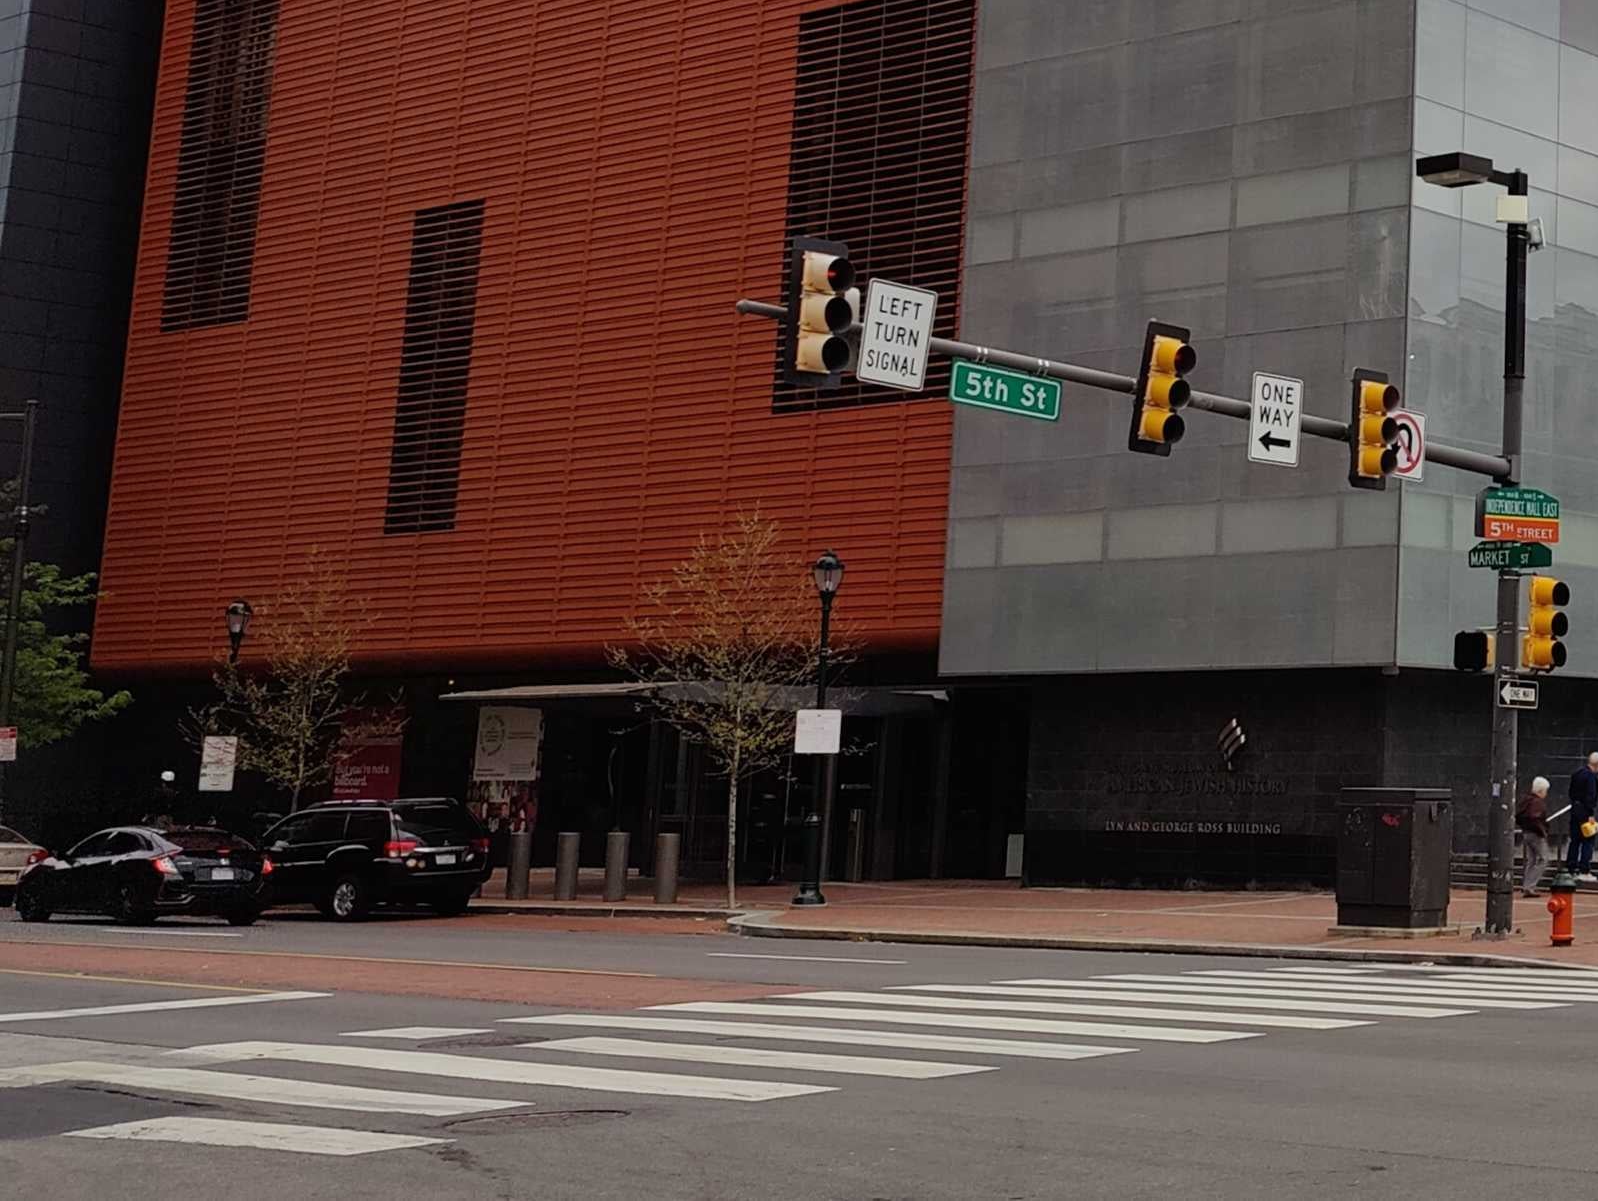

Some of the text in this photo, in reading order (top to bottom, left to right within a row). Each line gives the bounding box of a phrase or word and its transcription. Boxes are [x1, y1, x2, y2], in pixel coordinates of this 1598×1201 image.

[878, 294, 924, 321] LEFT
[874, 321, 920, 348] TURN
[866, 349, 919, 377] SIGNAL
[965, 372, 1048, 410] 5th St
[1261, 382, 1295, 406] ONE
[1259, 405, 1295, 428] WAY
[1486, 499, 1558, 517] INDEPENDENCE MALL EAST
[1490, 521, 1553, 539] 5TH STREET
[1470, 550, 1529, 565] MARKET ST
[1105, 820, 1281, 835] LYN AND GEORGE ROSS BUILDING
